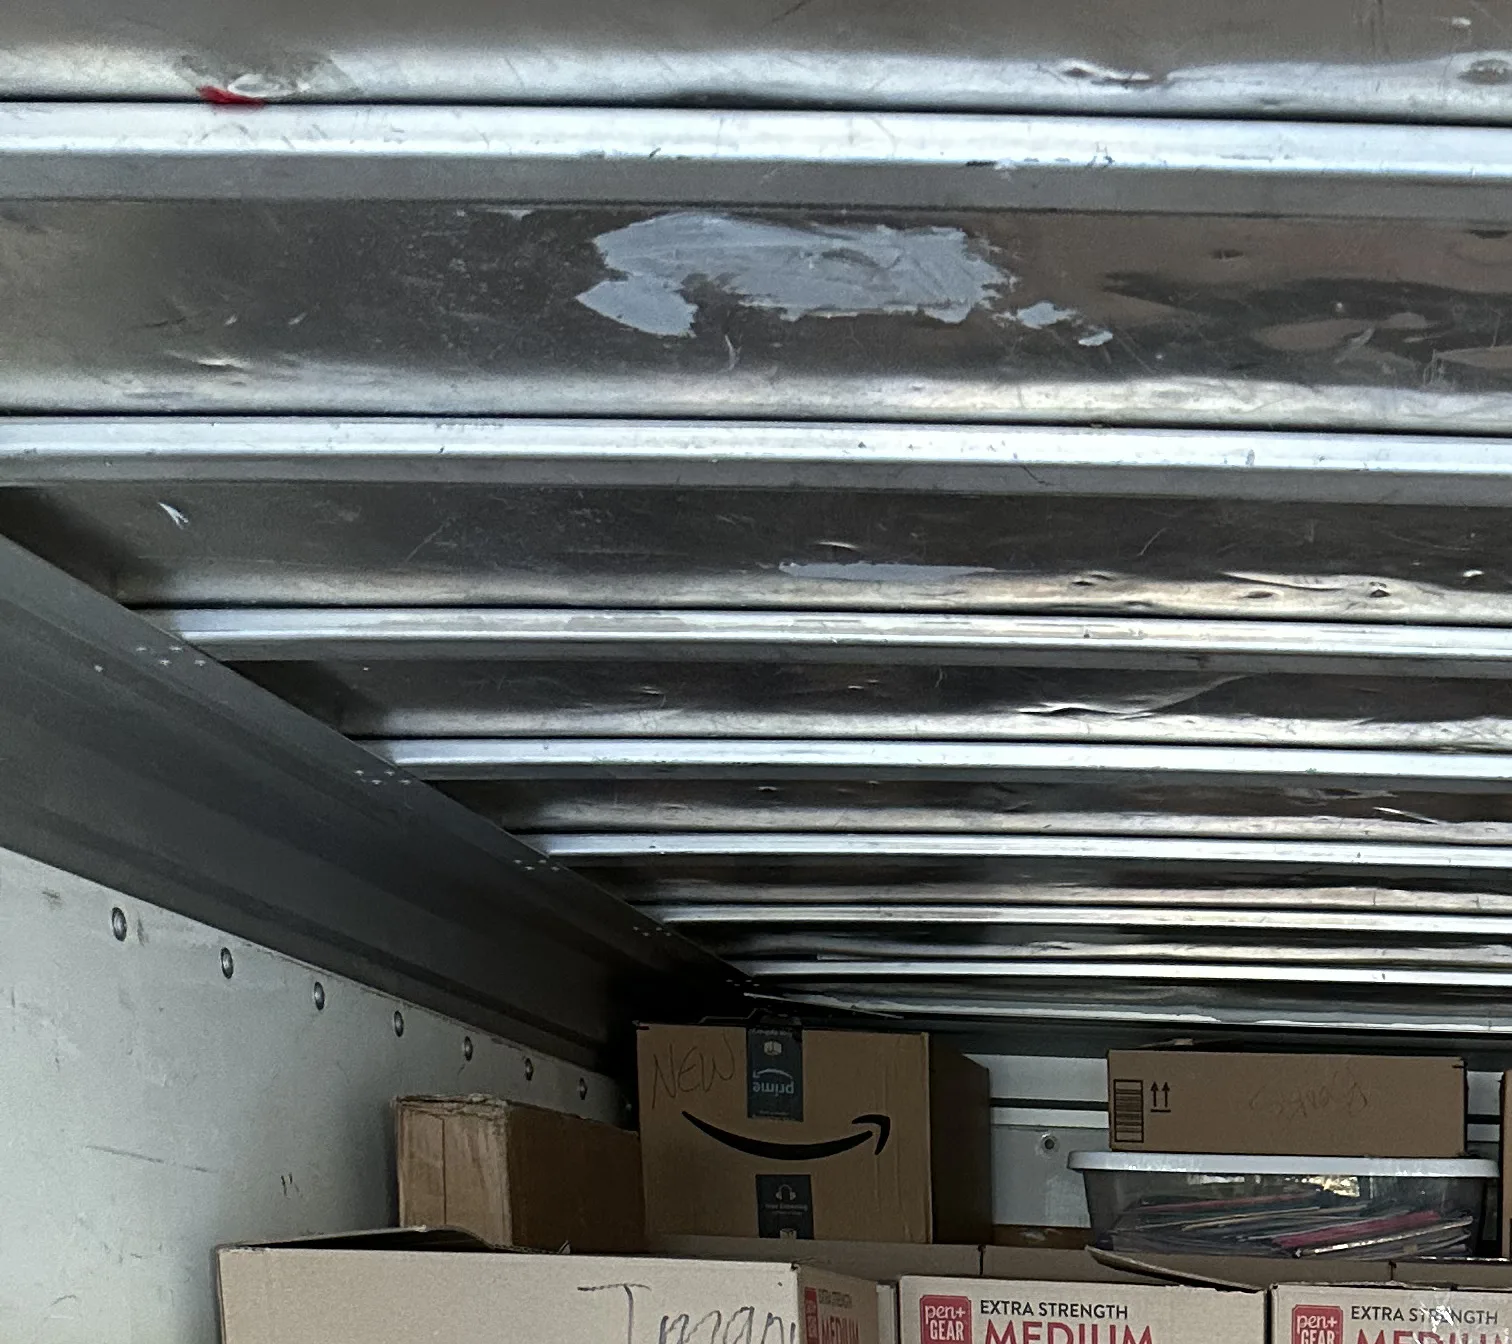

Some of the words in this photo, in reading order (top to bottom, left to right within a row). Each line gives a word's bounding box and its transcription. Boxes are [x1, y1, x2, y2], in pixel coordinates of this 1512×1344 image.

[753, 1080, 794, 1098] prime
[980, 1299, 1033, 1317] EXTRA
[1038, 1302, 1128, 1320] STRENGTH
[1351, 1306, 1404, 1322] EXTRA
[1409, 1308, 1498, 1325] STRENGTH
[930, 1320, 964, 1341] GEAR
